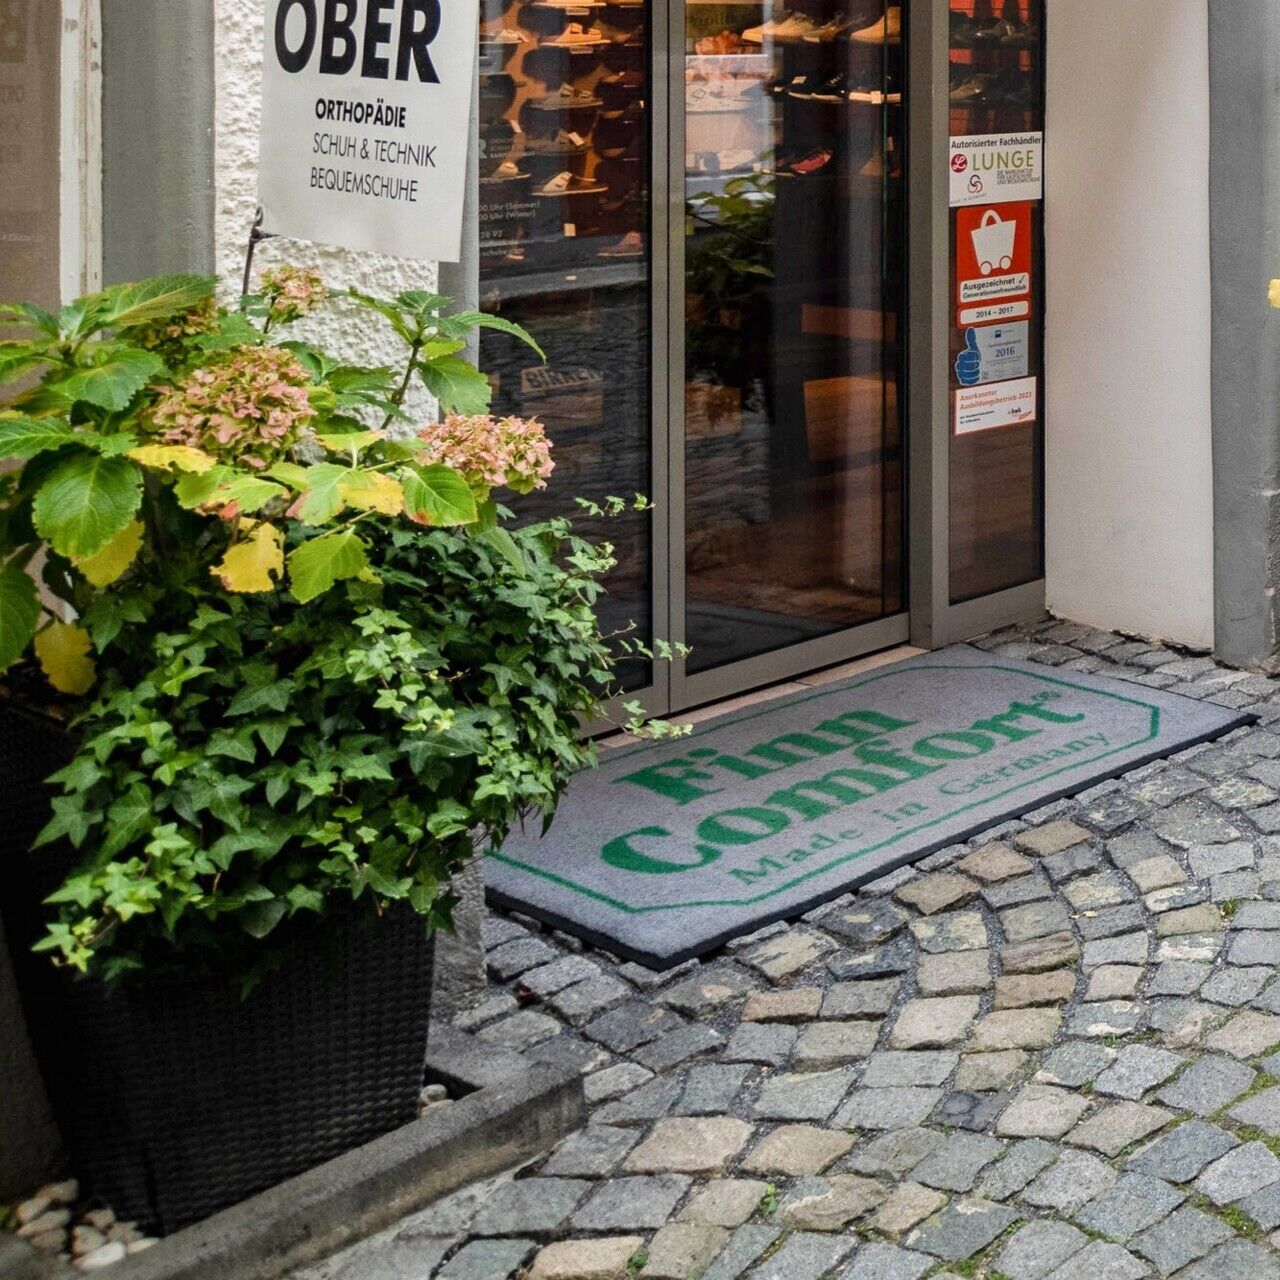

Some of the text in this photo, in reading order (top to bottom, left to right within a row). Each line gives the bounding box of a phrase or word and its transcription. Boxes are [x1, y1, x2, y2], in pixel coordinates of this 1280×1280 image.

[315, 97, 406, 128] ORTHOPÄDIE
[313, 133, 437, 167] SCHUH & TECHNIK
[951, 136, 1041, 149] Autorisierter Fachhändler
[973, 151, 1034, 171] LUNGE
[310, 166, 418, 202] BEQUEMSCHUHE
[962, 278, 1015, 291] Ausgezeichnet
[976, 309, 992, 319] 2014
[998, 307, 1014, 315] 2017
[995, 347, 1015, 357] 2016
[612, 707, 921, 807] Finn
[600, 699, 1086, 876] Comfort
[727, 731, 1110, 887] Made in Germany
